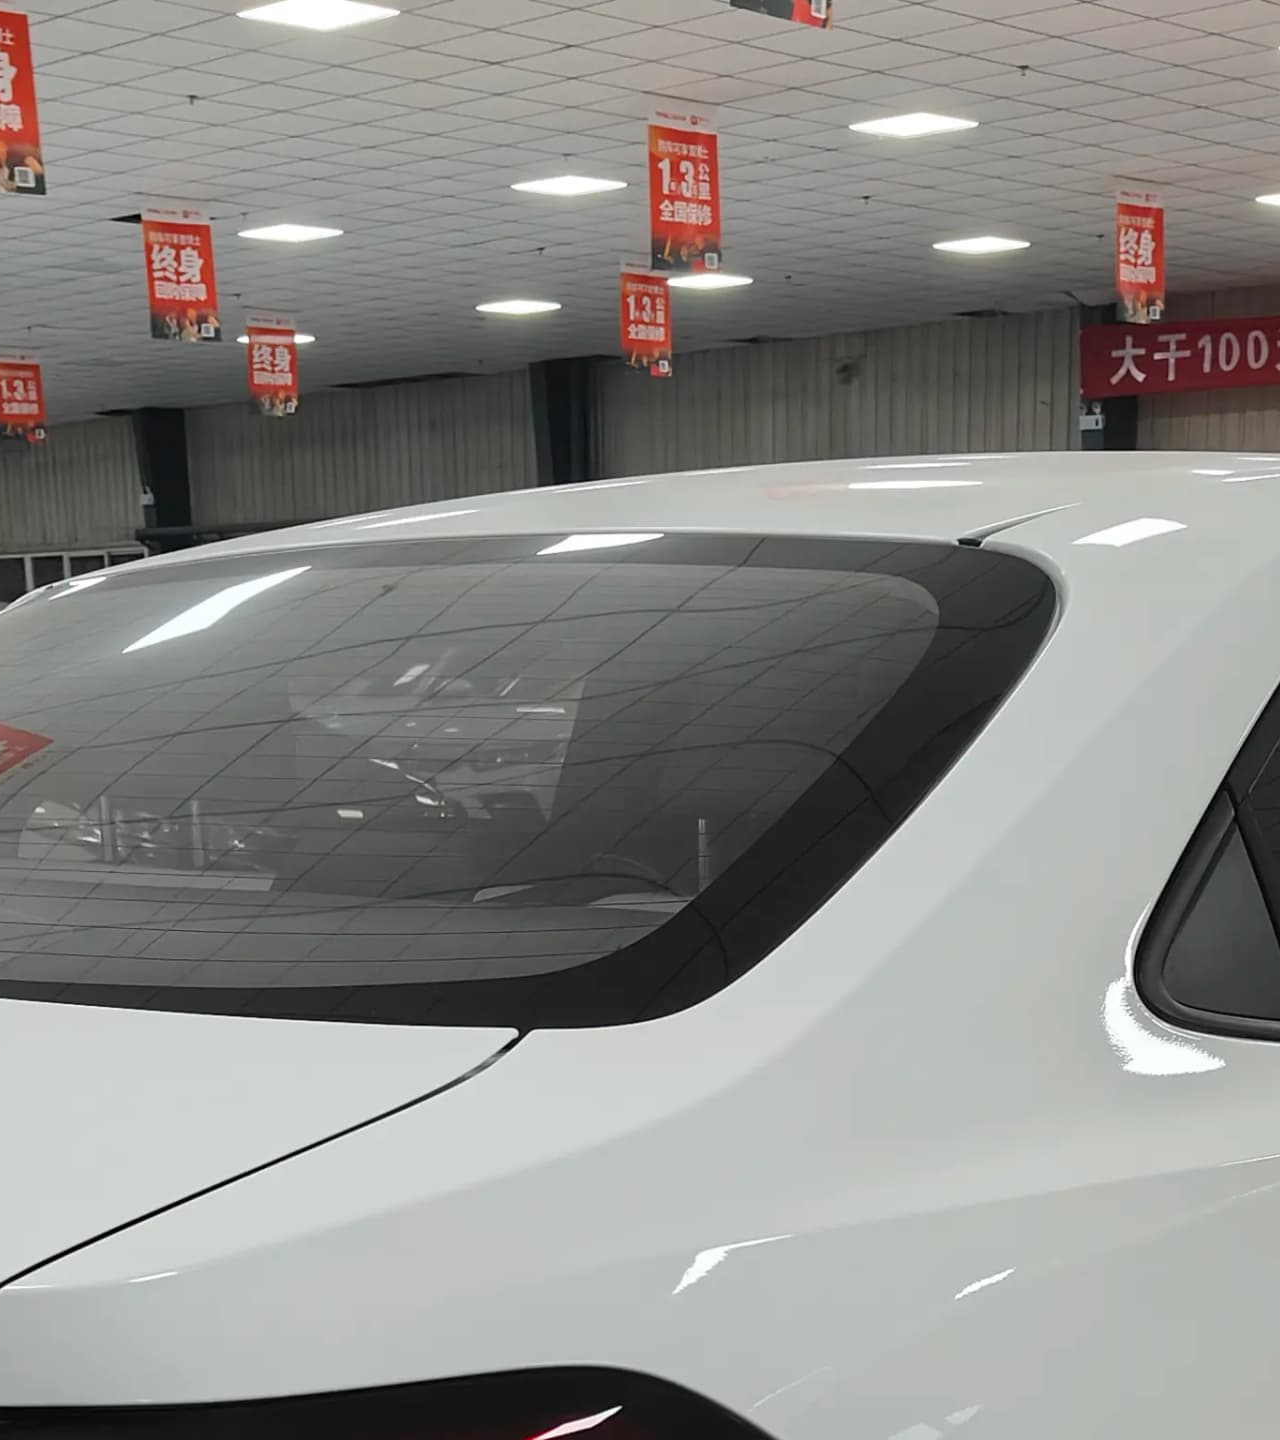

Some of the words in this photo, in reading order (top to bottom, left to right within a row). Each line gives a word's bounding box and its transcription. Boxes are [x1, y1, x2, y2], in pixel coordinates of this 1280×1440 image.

[151, 245, 204, 282] 终身
[1119, 227, 1156, 266] 终身
[252, 344, 291, 372] 终身
